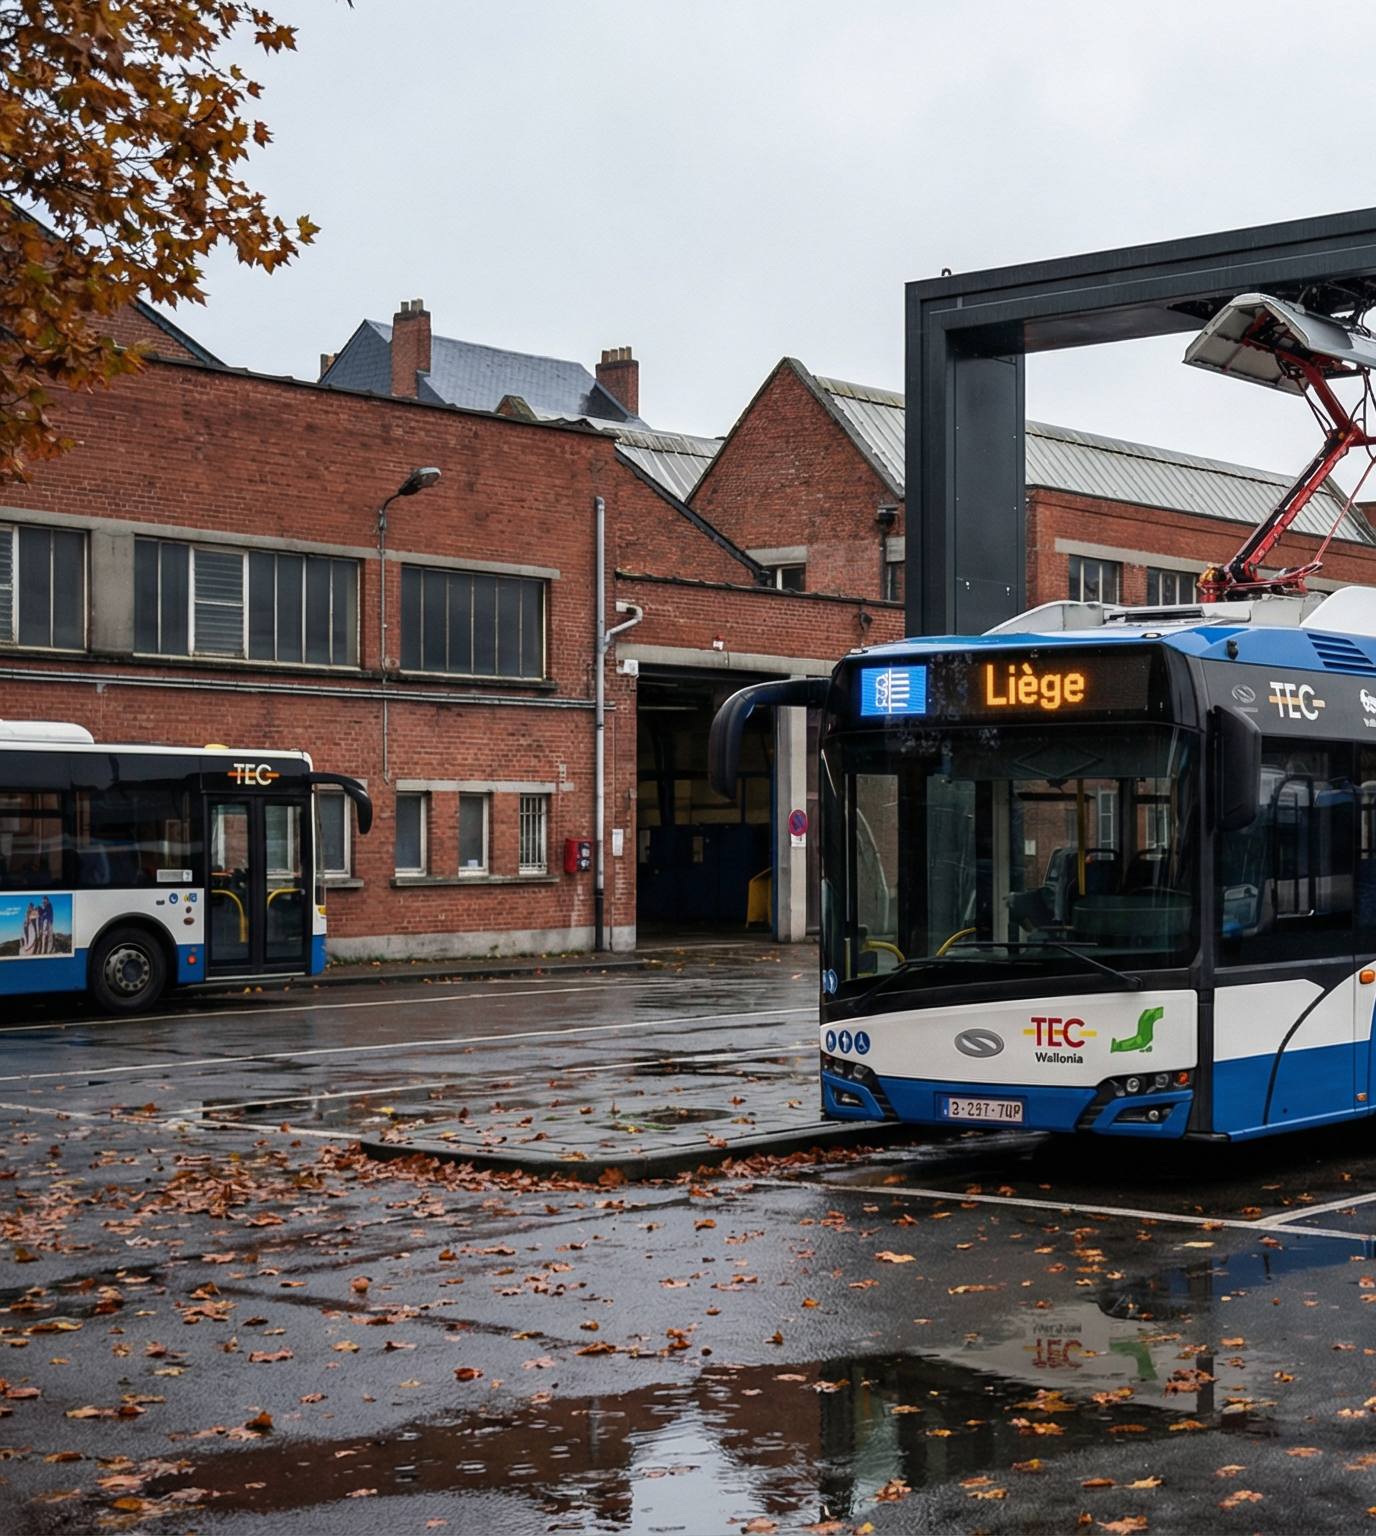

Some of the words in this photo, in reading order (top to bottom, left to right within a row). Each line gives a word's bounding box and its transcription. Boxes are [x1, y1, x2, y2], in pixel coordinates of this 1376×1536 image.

[986, 662, 1085, 709] Liège
[1269, 681, 1319, 721] TEC
[233, 763, 272, 786] TEC
[1030, 1016, 1085, 1048] TEC
